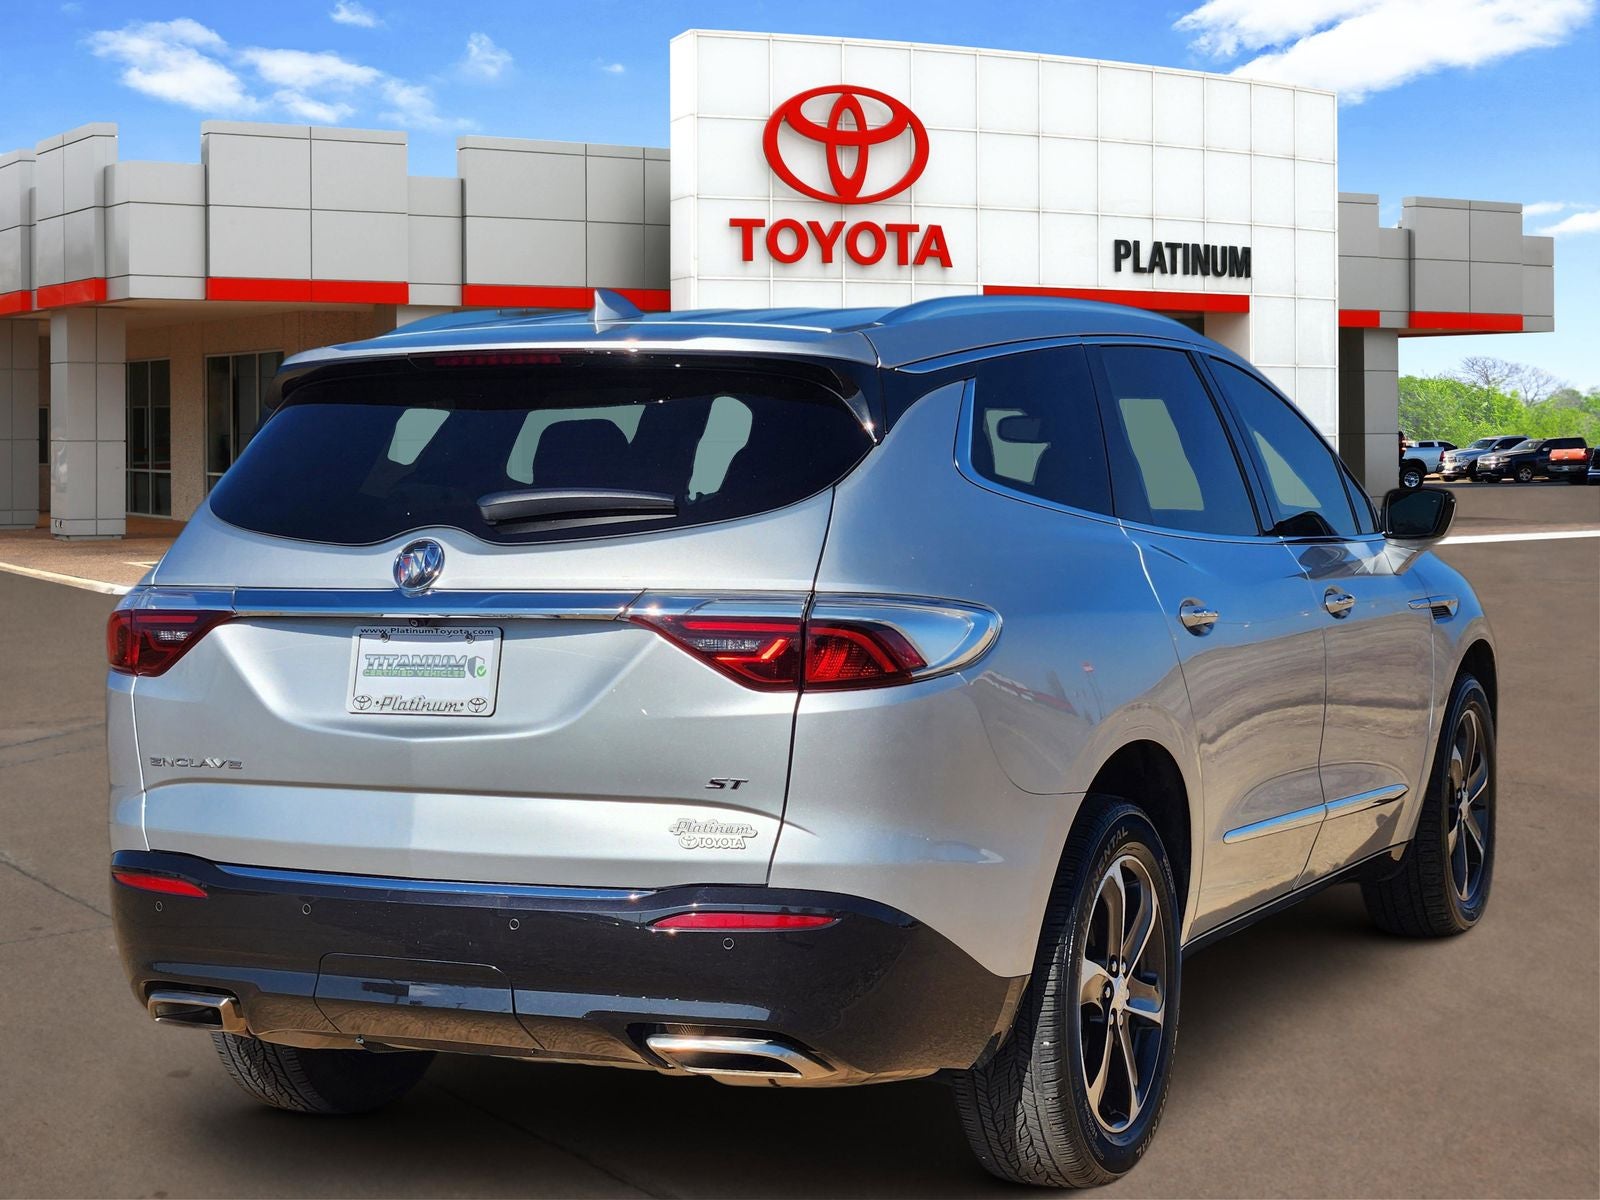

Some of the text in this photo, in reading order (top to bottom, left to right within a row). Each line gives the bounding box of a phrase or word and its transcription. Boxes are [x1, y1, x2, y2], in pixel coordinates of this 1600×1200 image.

[729, 218, 953, 268] TOYOTA
[1114, 239, 1252, 278] PLATINUM
[360, 627, 494, 637] www.PlatinumToyota.com
[364, 654, 468, 670] TITANIUM
[379, 695, 461, 712] Platinum
[150, 757, 243, 769] ENCLAVE
[705, 777, 749, 790] ST
[669, 818, 758, 838] Platinum
[699, 837, 744, 849] TOYOTA
